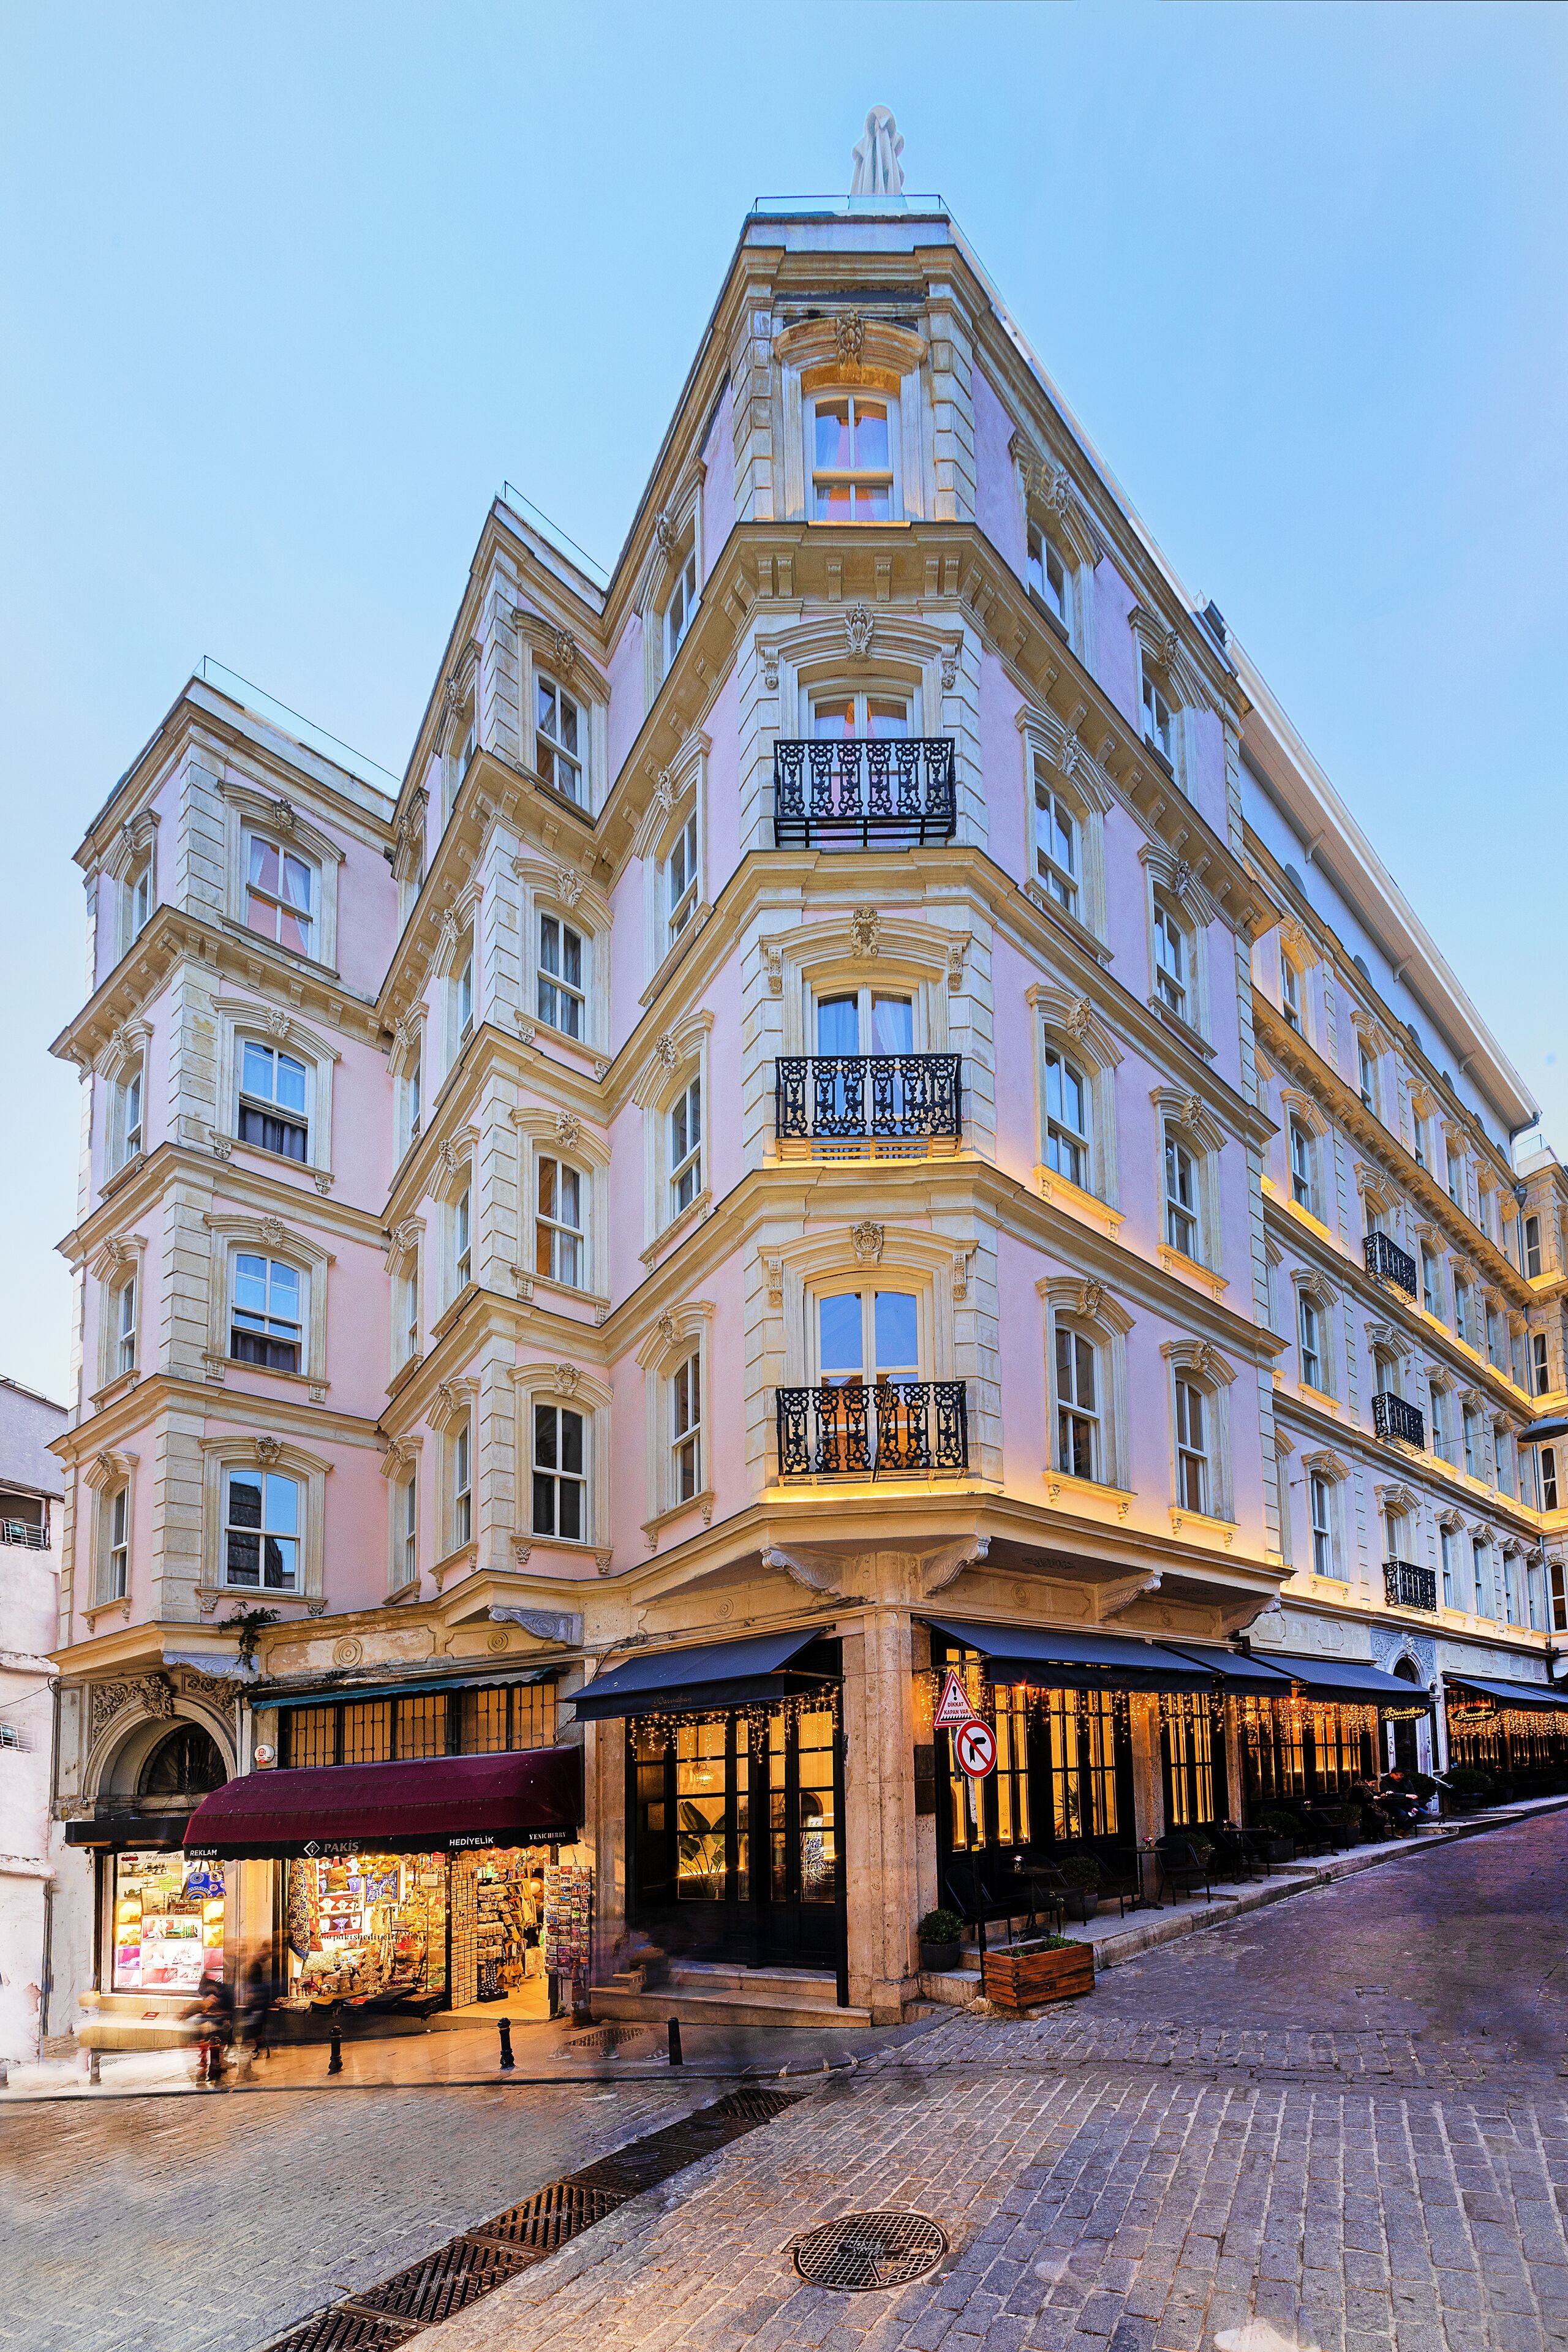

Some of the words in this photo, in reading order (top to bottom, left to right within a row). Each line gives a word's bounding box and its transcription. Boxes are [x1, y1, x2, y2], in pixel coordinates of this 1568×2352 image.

[1381, 1707, 1426, 1719] Barnathan
[1455, 1709, 1494, 1720] Barnathan
[324, 1839, 359, 1854] PAKİŞ
[449, 1836, 494, 1846] HEDİYELİK
